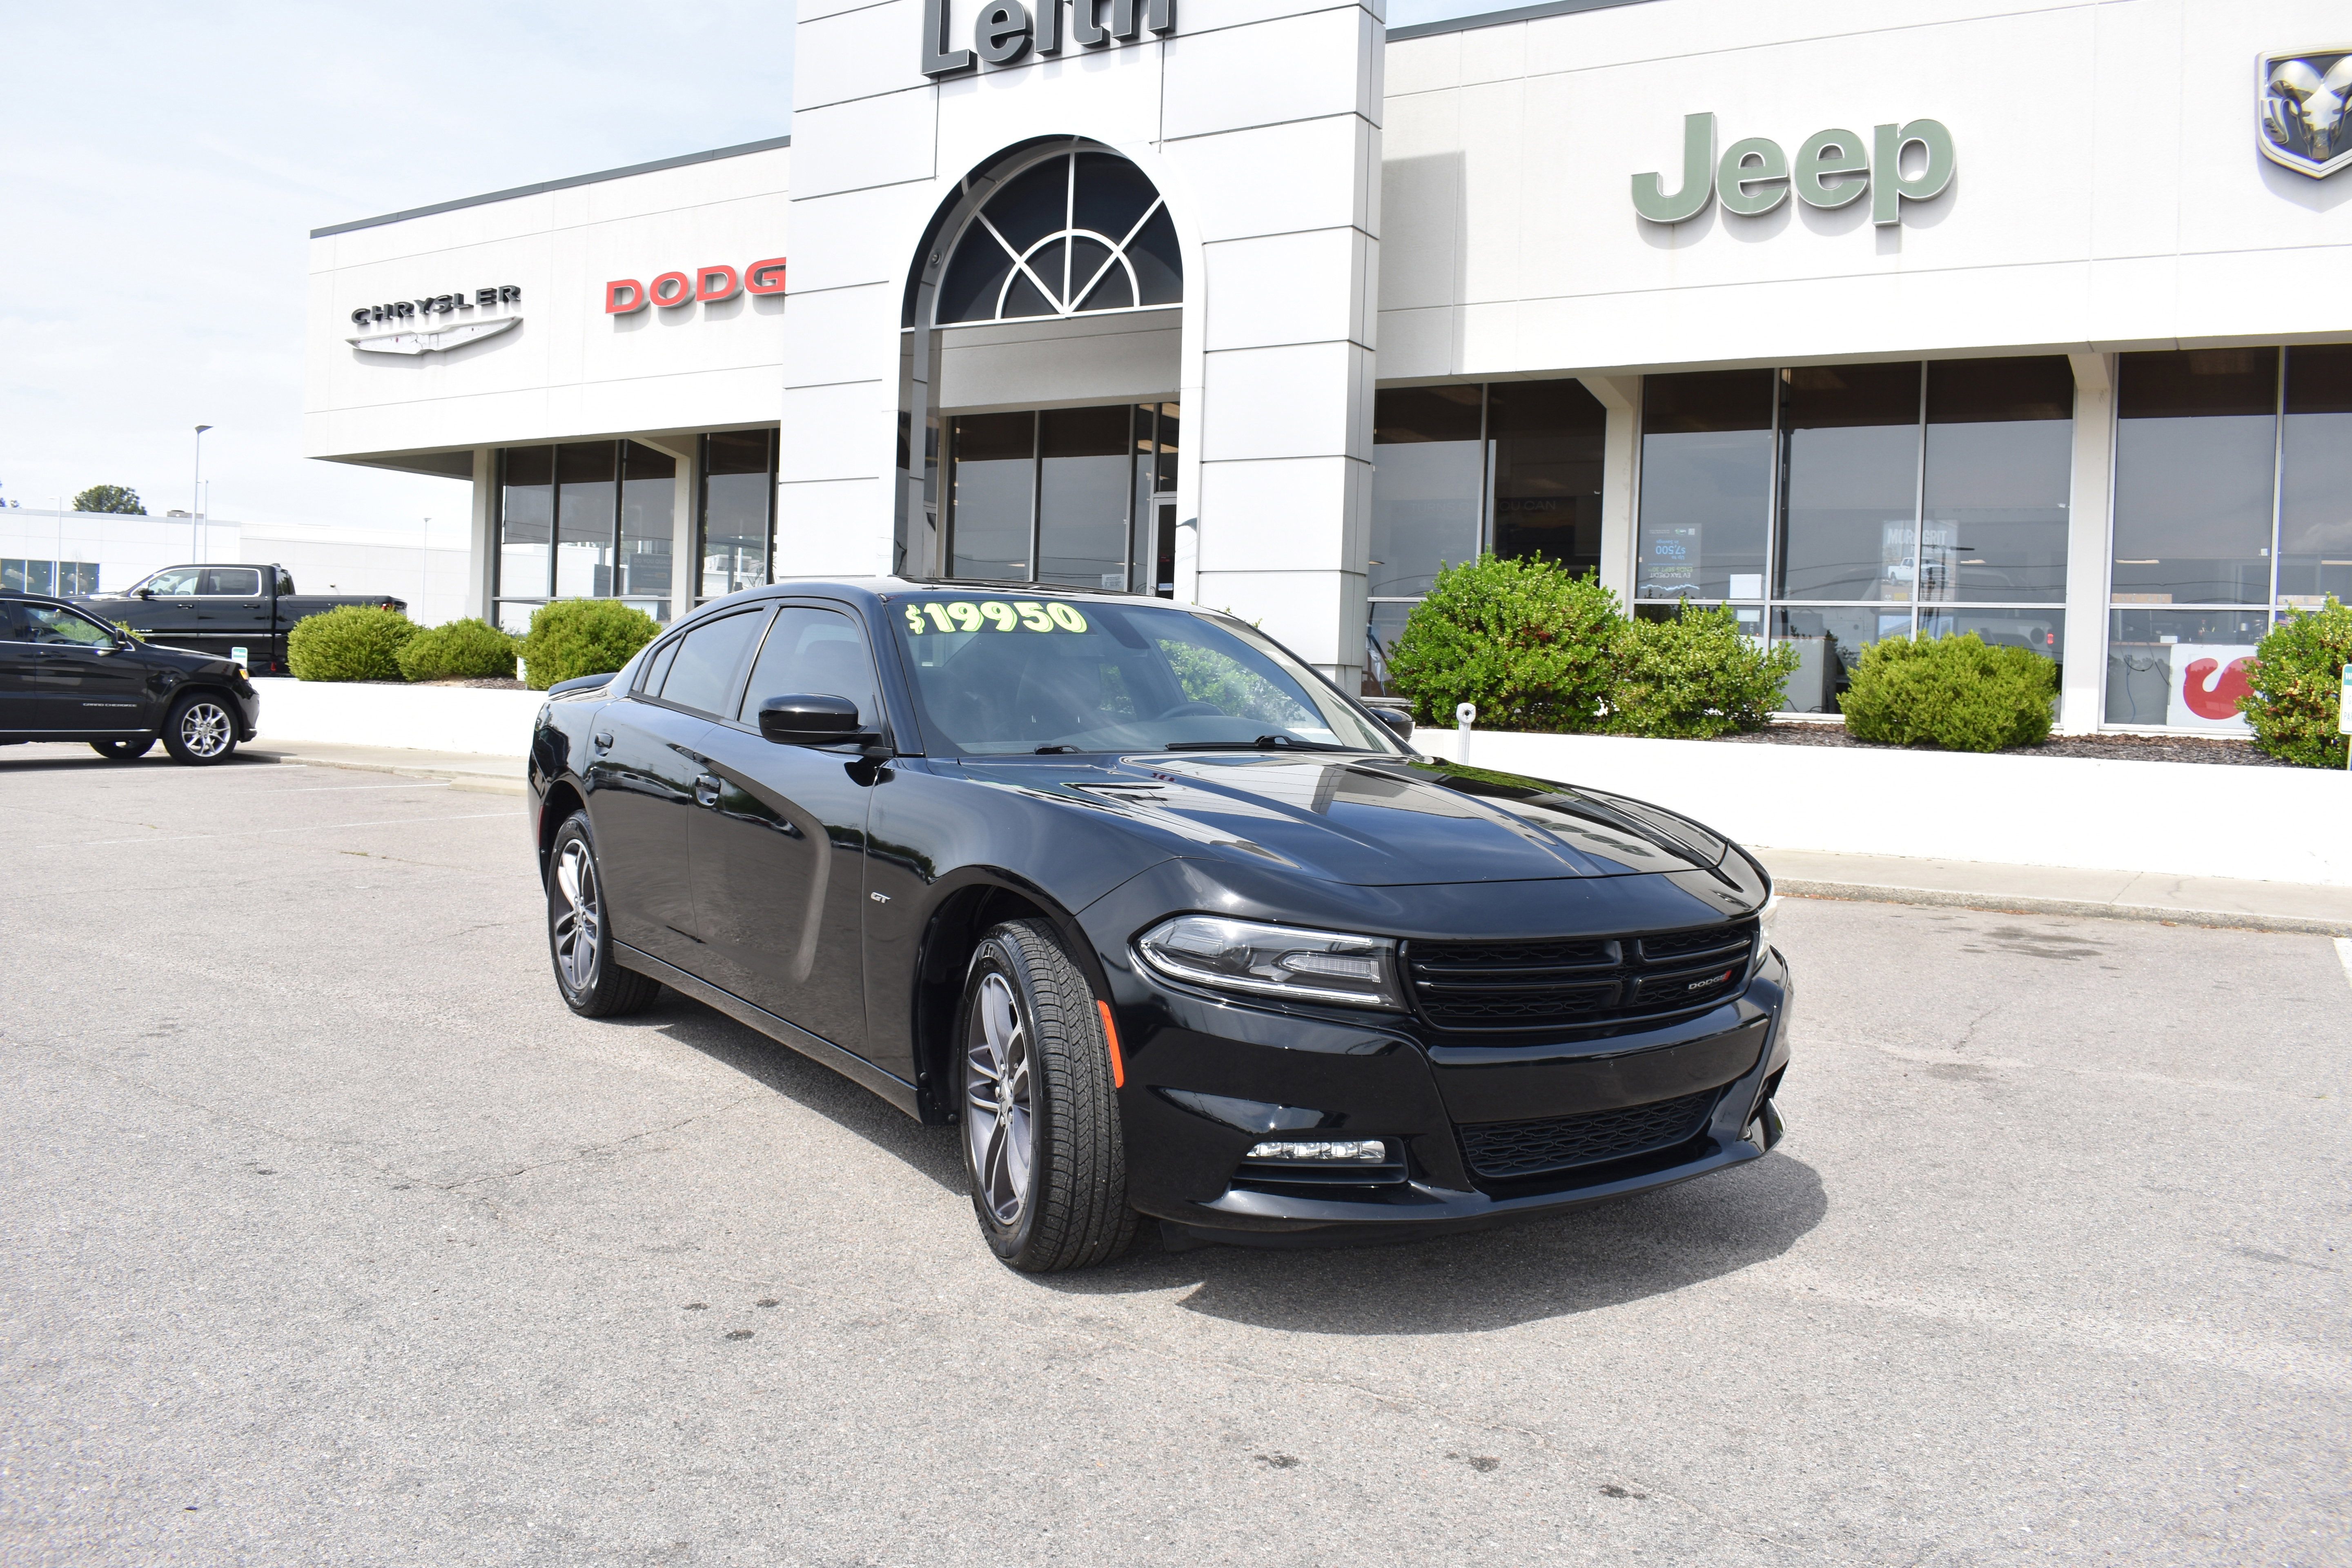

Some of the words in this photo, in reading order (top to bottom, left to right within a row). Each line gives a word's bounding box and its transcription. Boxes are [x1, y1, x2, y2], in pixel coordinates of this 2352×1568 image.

[1630, 111, 1956, 227] Jeep
[605, 256, 786, 316] DODG
[351, 284, 521, 326] CHRYSLER
[1499, 500, 1520, 511] OU
[1524, 500, 1556, 510] CAN
[1888, 529, 1915, 544] MOR
[1924, 530, 1947, 545] GRIT
[1656, 545, 1686, 555] $7,500
[905, 601, 1088, 635] $19950
[871, 892, 892, 904] GT
[1688, 973, 1727, 990] DODGE
